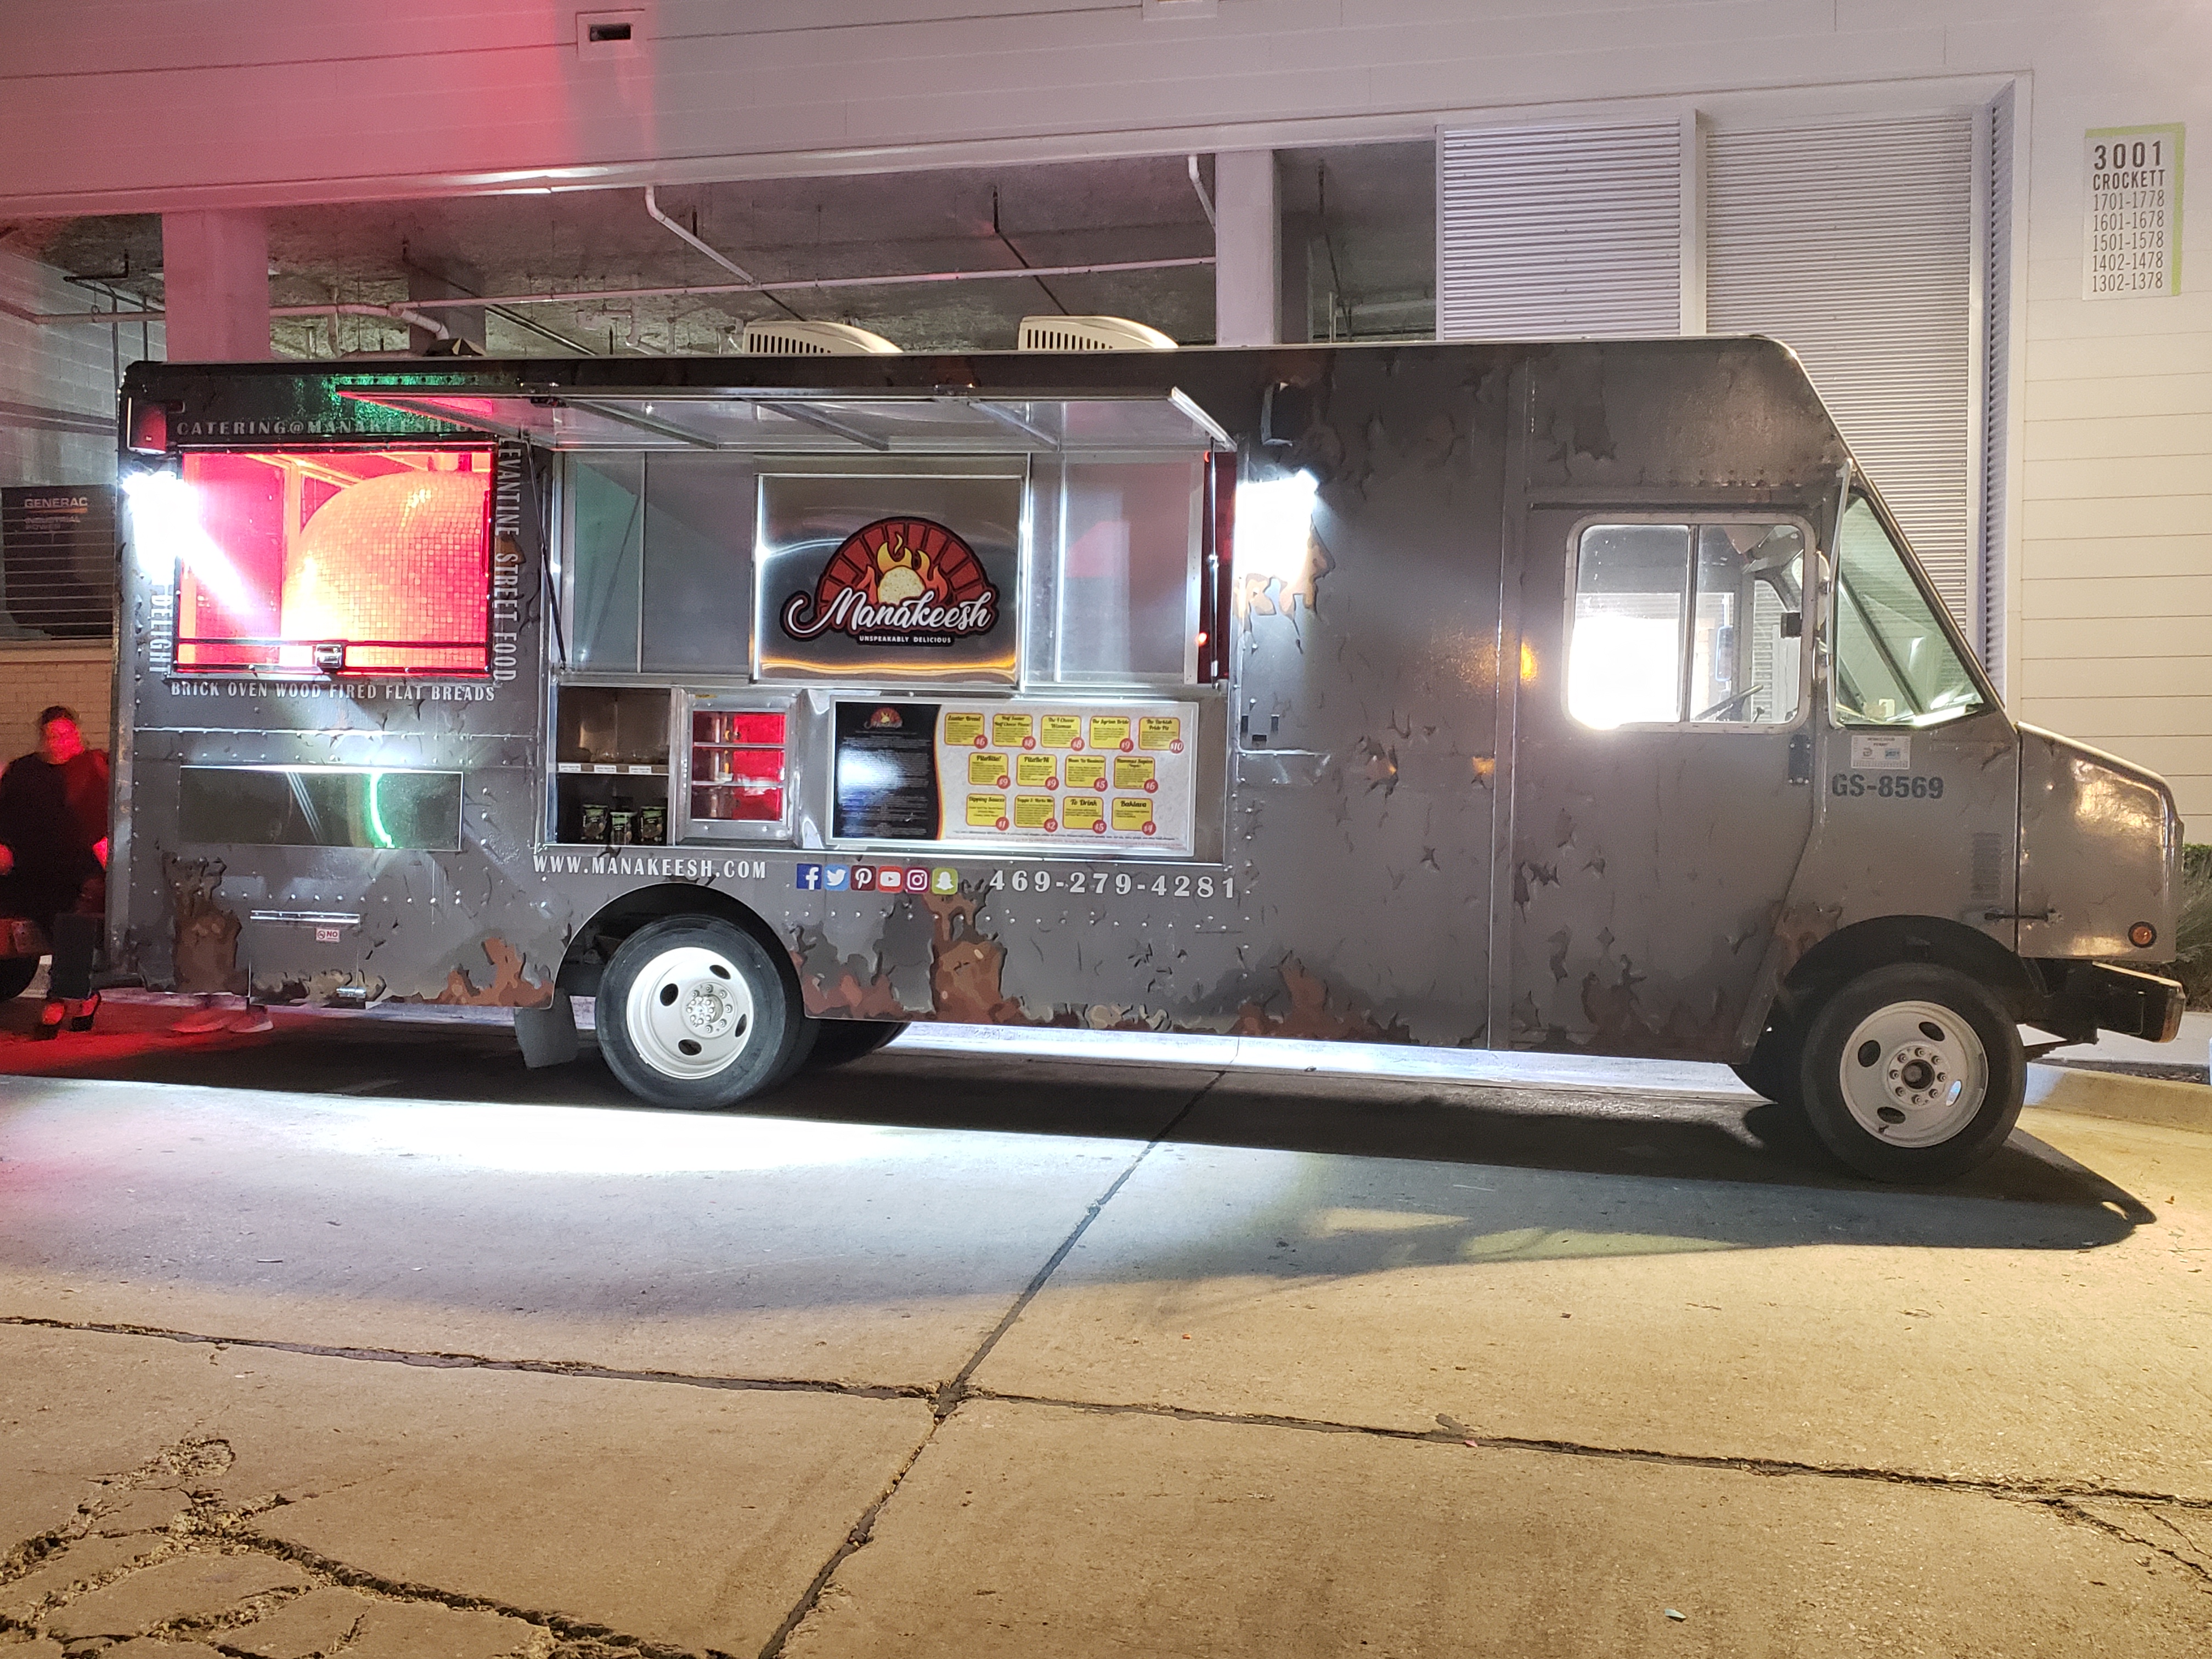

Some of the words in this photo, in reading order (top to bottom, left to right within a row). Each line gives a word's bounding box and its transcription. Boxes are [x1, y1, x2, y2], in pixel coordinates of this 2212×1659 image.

[2094, 140, 2161, 170] 3001
[2093, 170, 2165, 190] CROCKETT
[2094, 190, 2164, 211] 1701-1778
[2093, 210, 2164, 232] 1601-1678
[2093, 230, 2164, 252] 1501-1578
[2092, 251, 2163, 272] 1402-1478
[2092, 272, 2163, 292] 1302-1378
[25, 497, 88, 508] GENERAC
[494, 553, 518, 621] STREET
[788, 587, 991, 633] Manakeesh
[149, 595, 173, 674] DELIGHT
[493, 633, 517, 681] FOOD
[171, 682, 219, 696] BRICK
[228, 683, 267, 697] OVEN
[276, 683, 321, 698] WOOD
[329, 684, 377, 699] FIRED
[386, 685, 423, 700] FLAT
[431, 686, 495, 701] BREADS
[1121, 741, 1130, 749] $9
[1146, 782, 1156, 790] $6
[1832, 774, 1944, 799] GS-8569
[1094, 823, 1104, 832] $5
[533, 855, 766, 878] WWW.MANAKEESH.COM
[989, 870, 1234, 898] 469-279-4281
